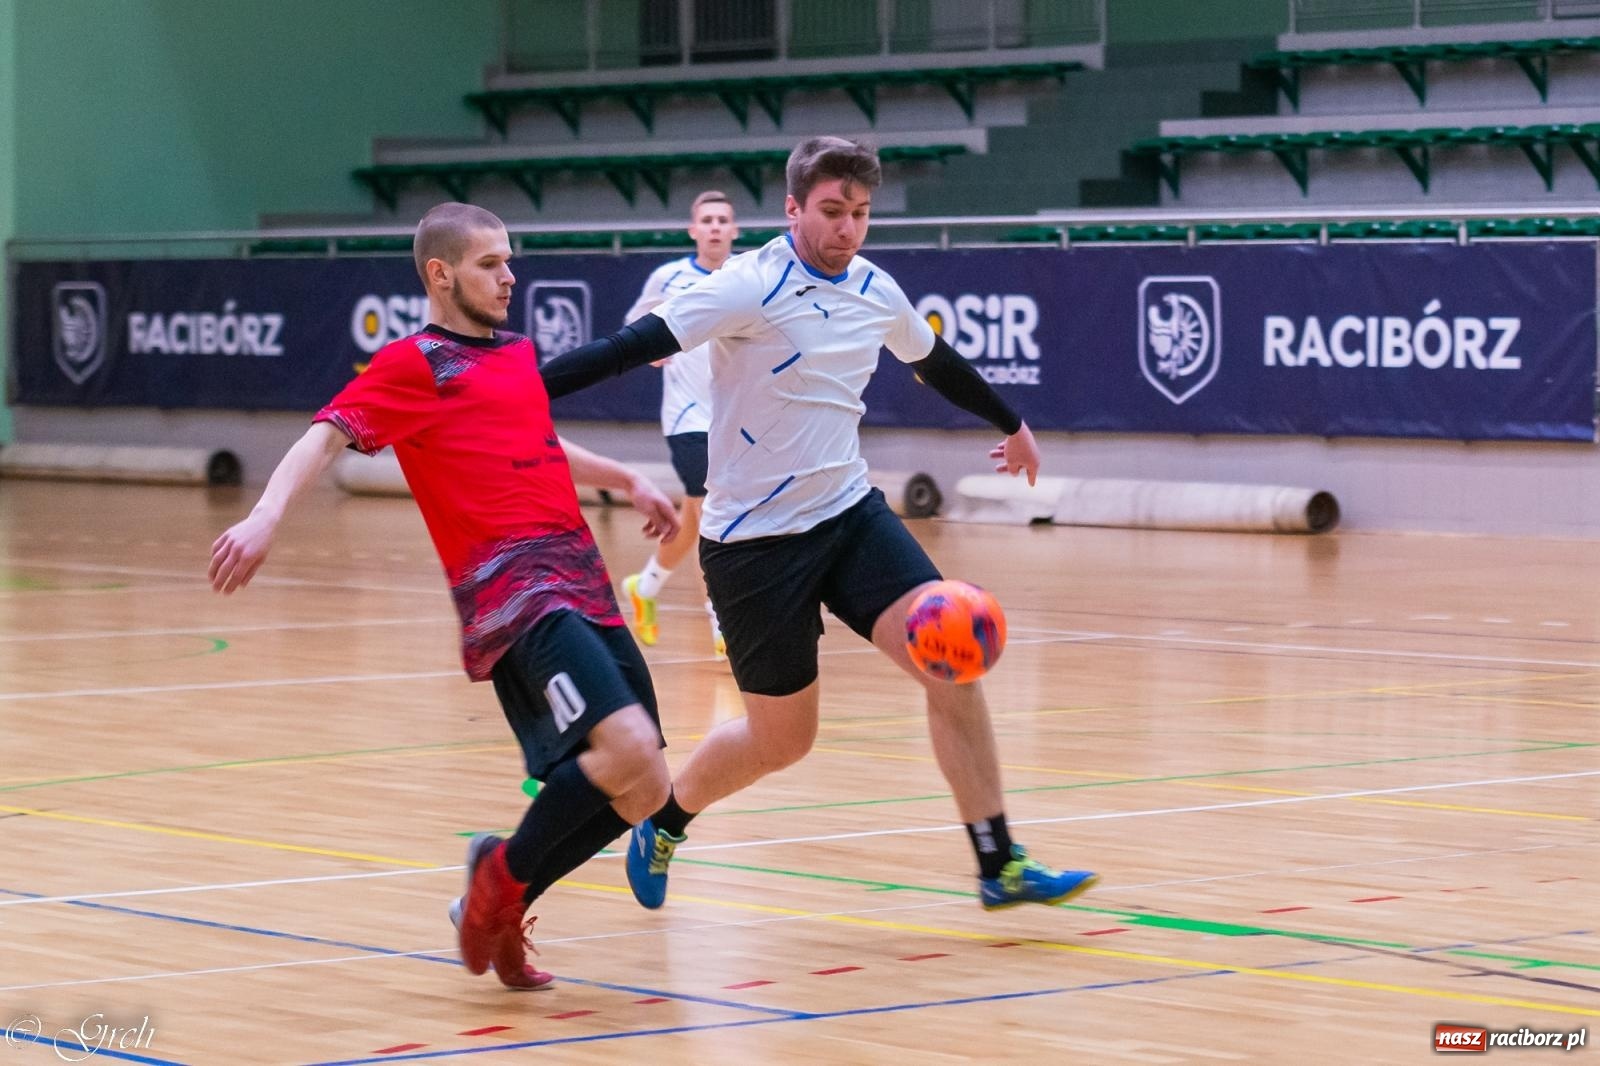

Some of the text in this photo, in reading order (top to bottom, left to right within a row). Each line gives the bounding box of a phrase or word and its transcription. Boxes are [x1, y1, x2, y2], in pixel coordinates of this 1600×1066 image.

[128, 300, 284, 356] RACIBÓRZ
[352, 294, 431, 353] OSi
[1264, 299, 1522, 370] RACIBÓRZ
[543, 671, 587, 734] 10
